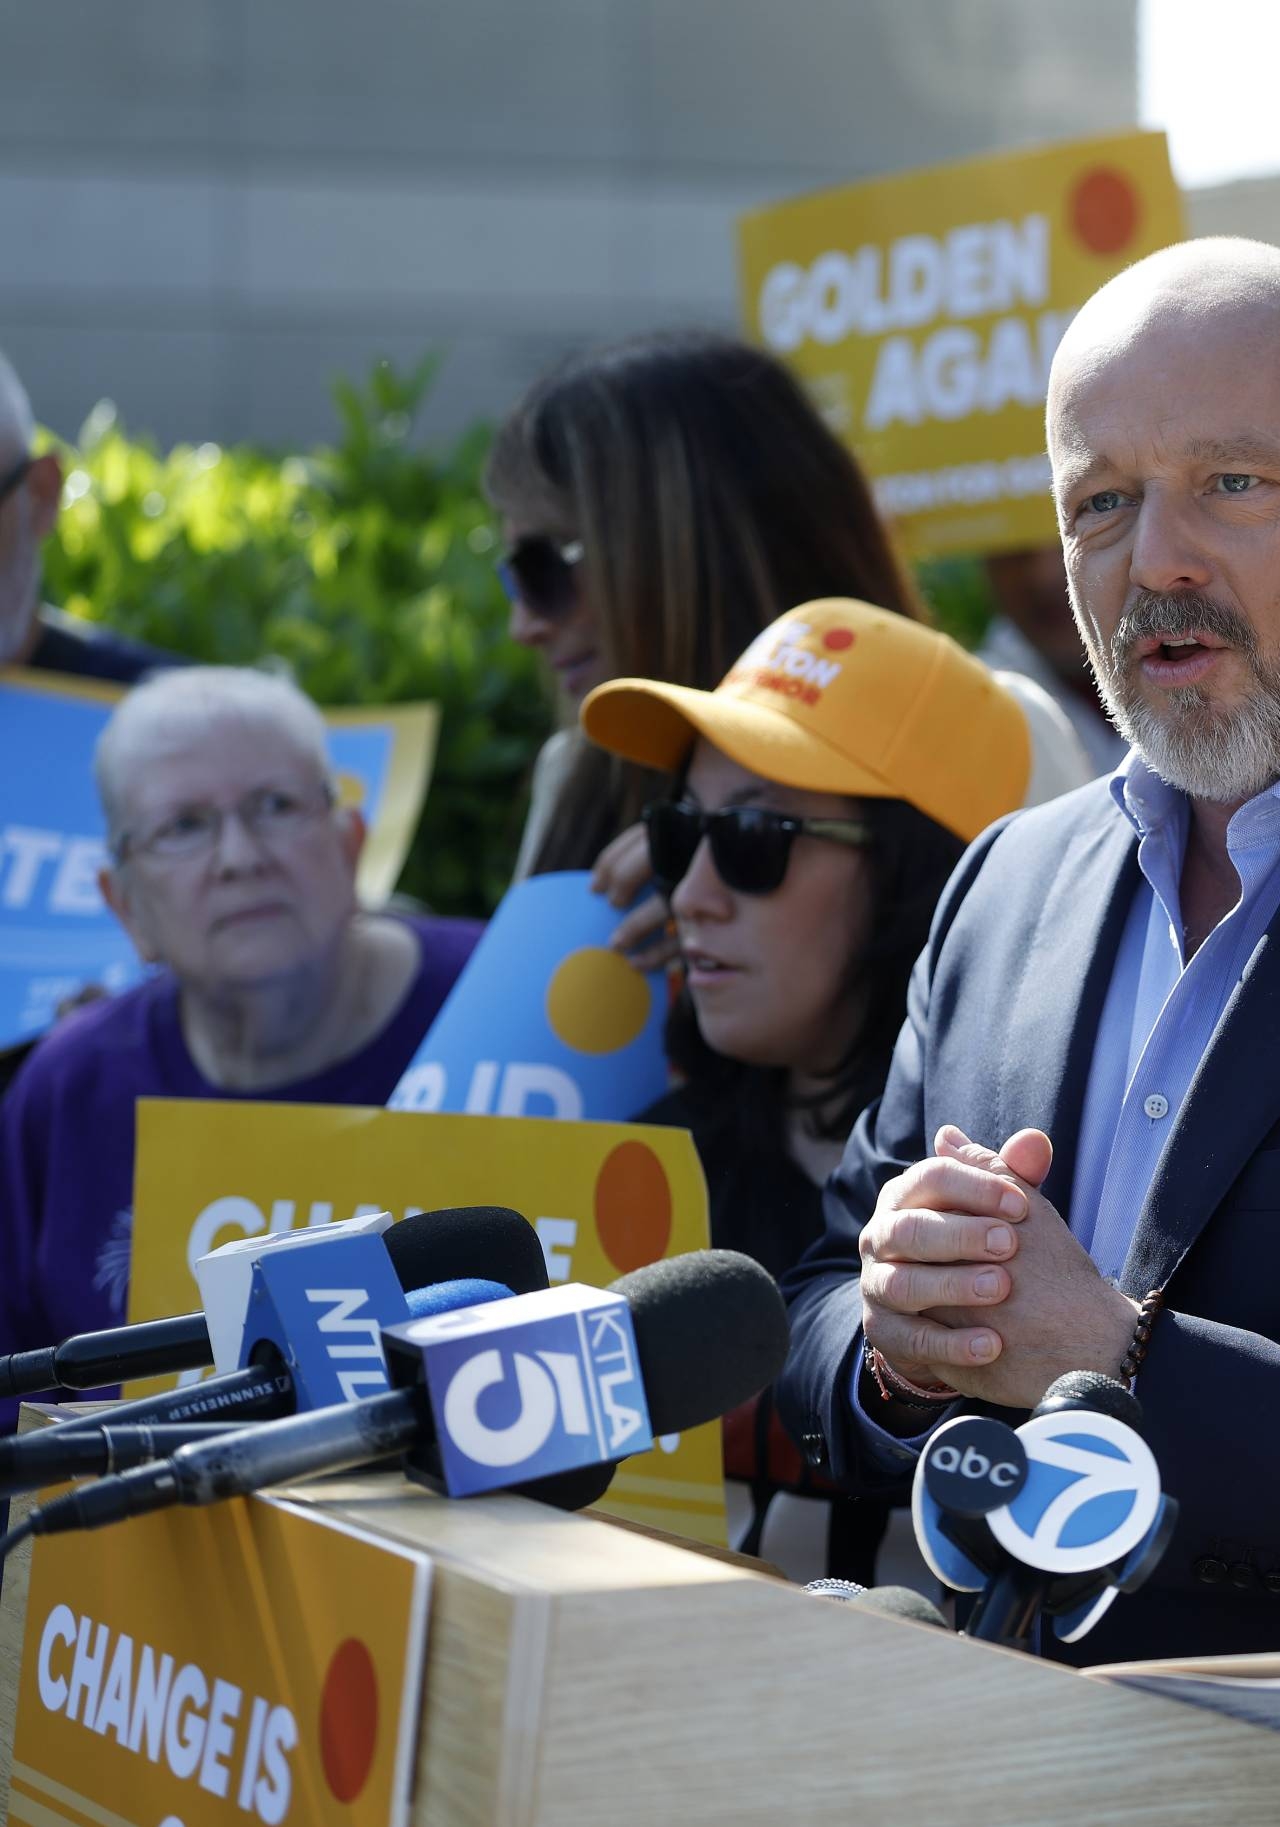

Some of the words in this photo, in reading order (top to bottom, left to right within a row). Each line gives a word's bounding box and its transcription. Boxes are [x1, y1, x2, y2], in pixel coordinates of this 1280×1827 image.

[760, 212, 1050, 351] GOLDEN
[863, 308, 1075, 432] AGAI
[168, 1381, 275, 1421] SENNHEISER
[444, 1348, 590, 1467] 5
[588, 1308, 643, 1450] KTLA
[930, 1445, 1020, 1487] abc
[37, 1603, 243, 1799] CHANGE
[237, 1695, 299, 1826] IS
